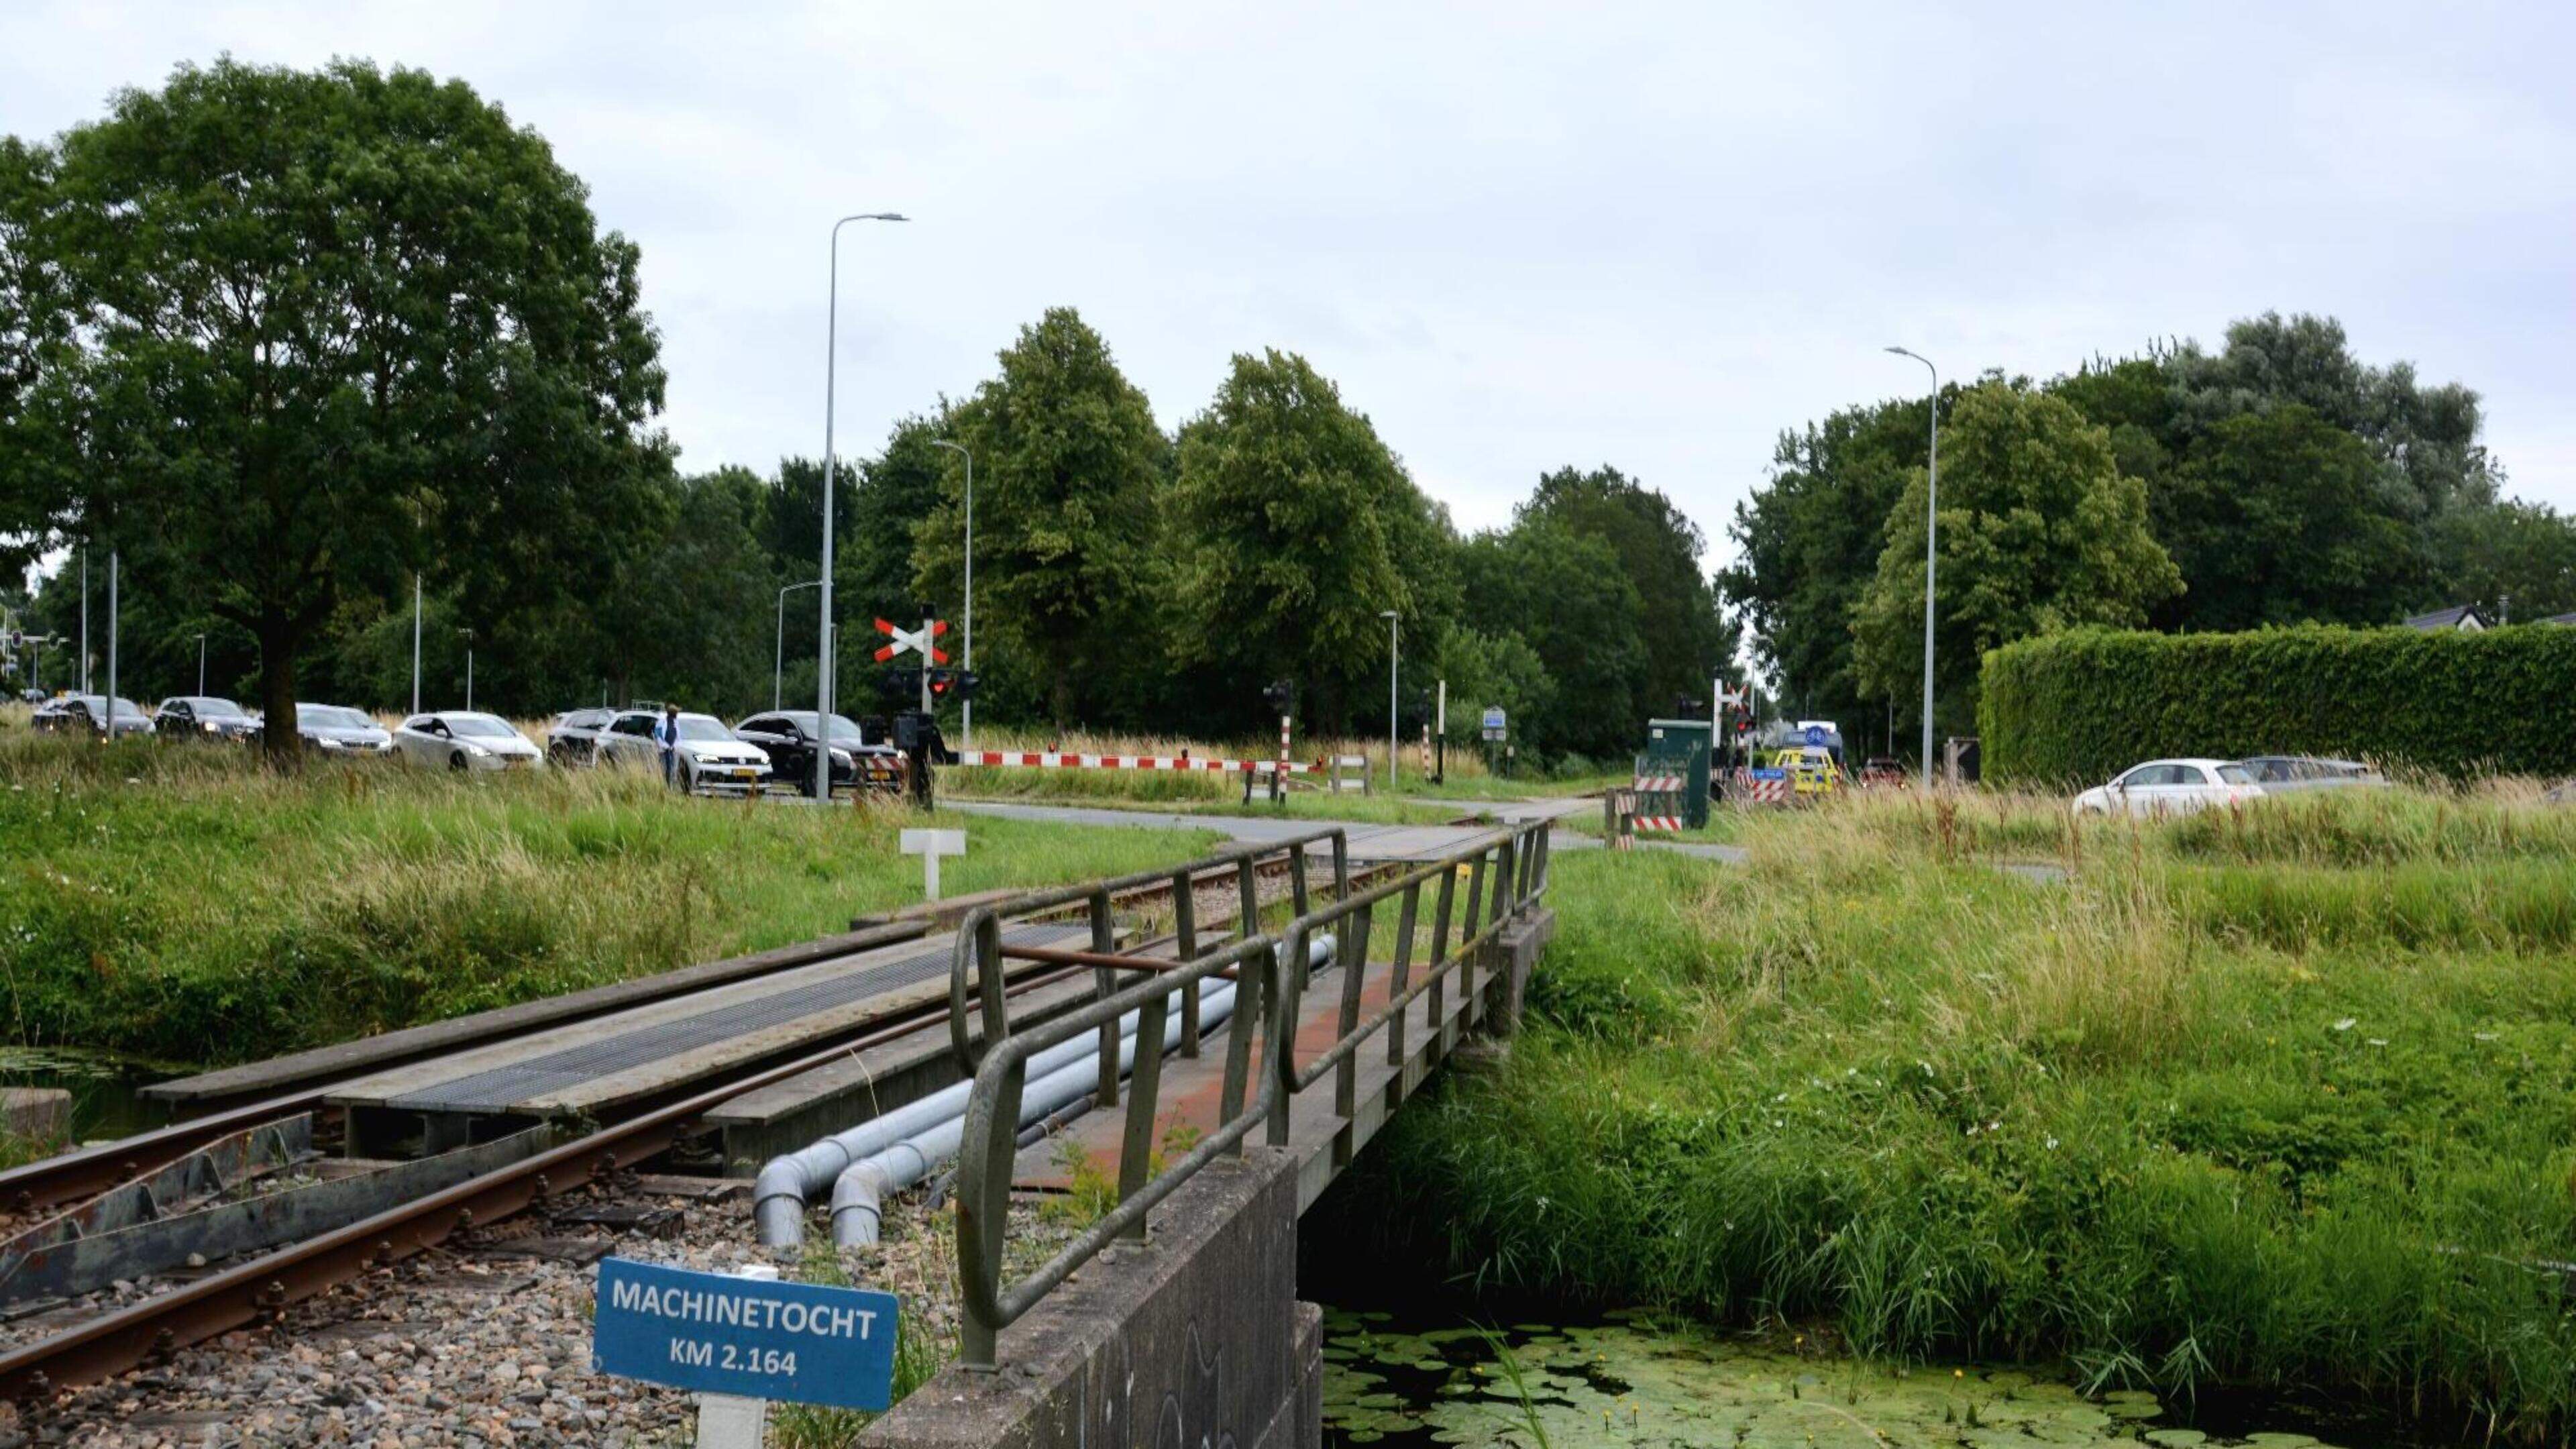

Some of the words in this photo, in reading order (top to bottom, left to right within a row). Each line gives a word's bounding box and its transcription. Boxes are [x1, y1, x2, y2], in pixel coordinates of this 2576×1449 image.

[612, 1279, 877, 1340] MACHINETOCHT
[669, 1338, 712, 1367] KM
[721, 1344, 797, 1377] 2.164
